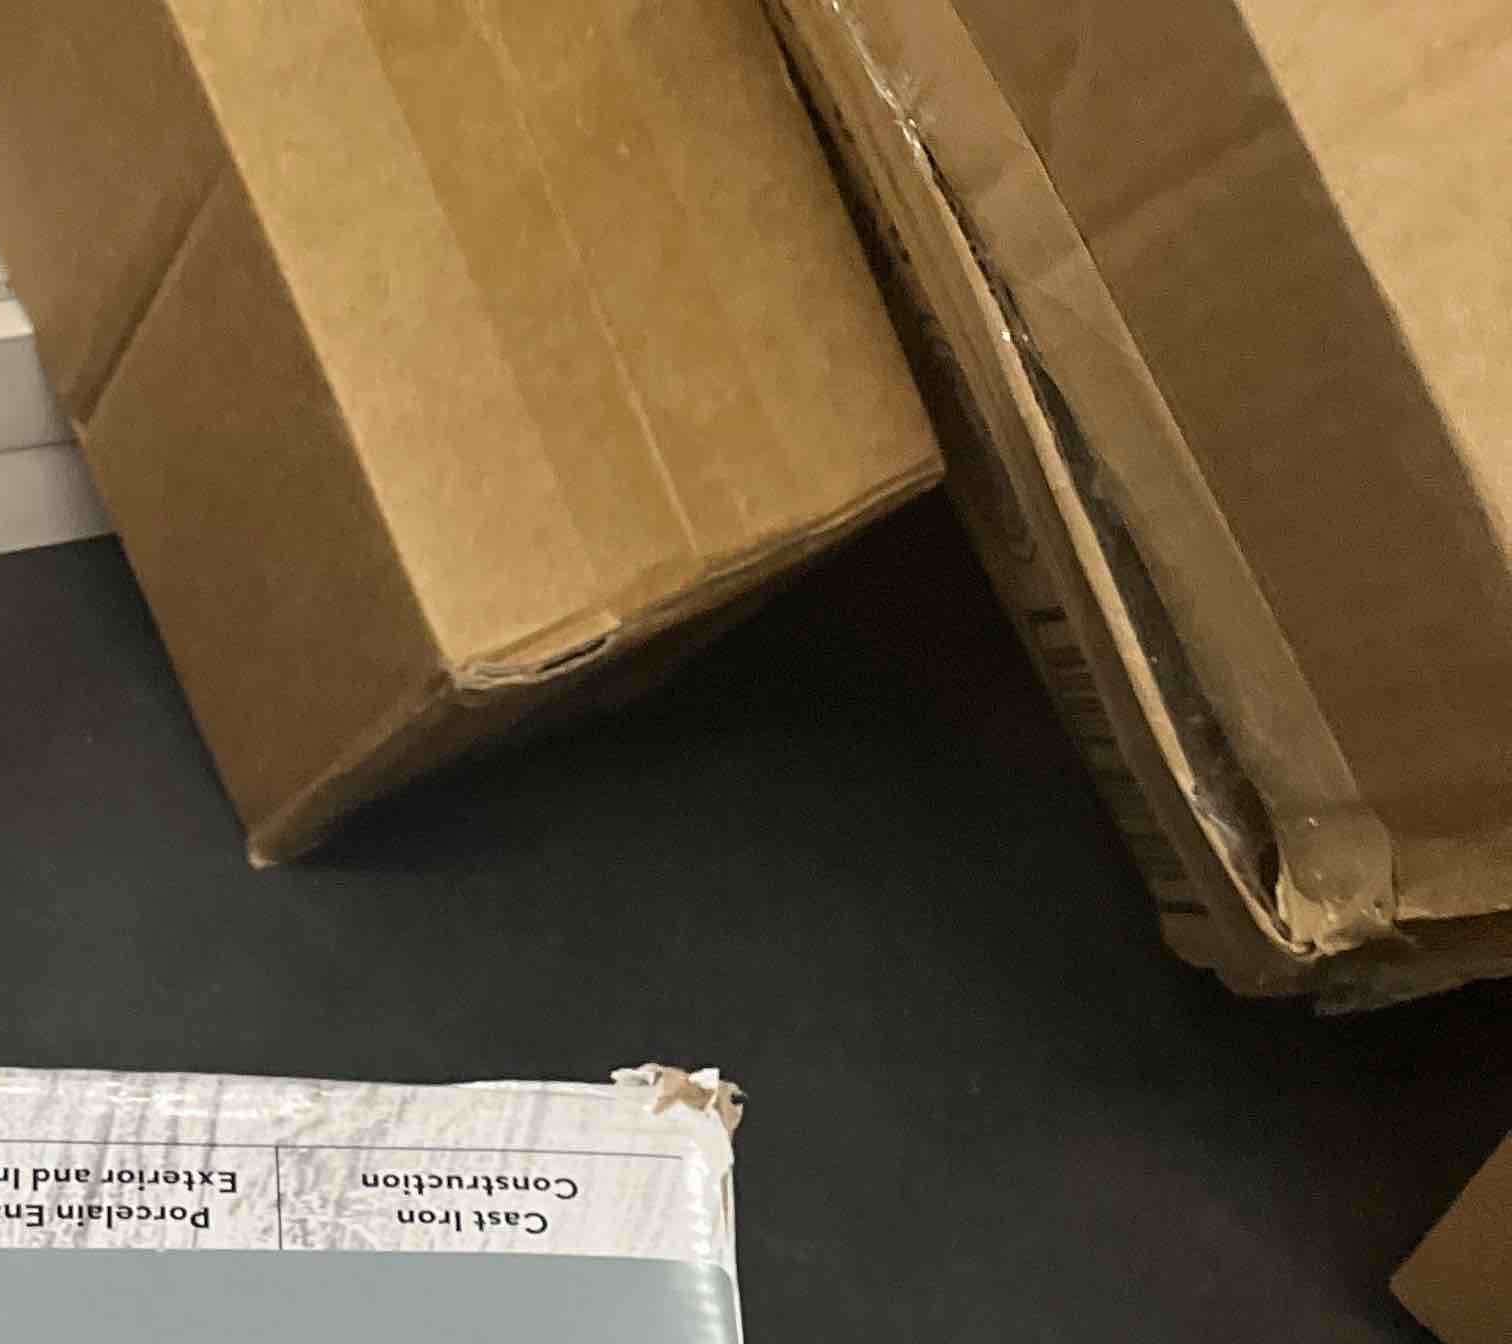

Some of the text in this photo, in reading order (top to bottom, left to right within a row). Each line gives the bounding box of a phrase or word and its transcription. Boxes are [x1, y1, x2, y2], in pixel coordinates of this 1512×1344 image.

[30, 1164, 91, 1191] and
[99, 1166, 238, 1193] Exterior
[361, 1170, 579, 1199] Construction
[56, 1202, 210, 1230] Porcelain
[395, 1206, 549, 1234] Cast Iron
